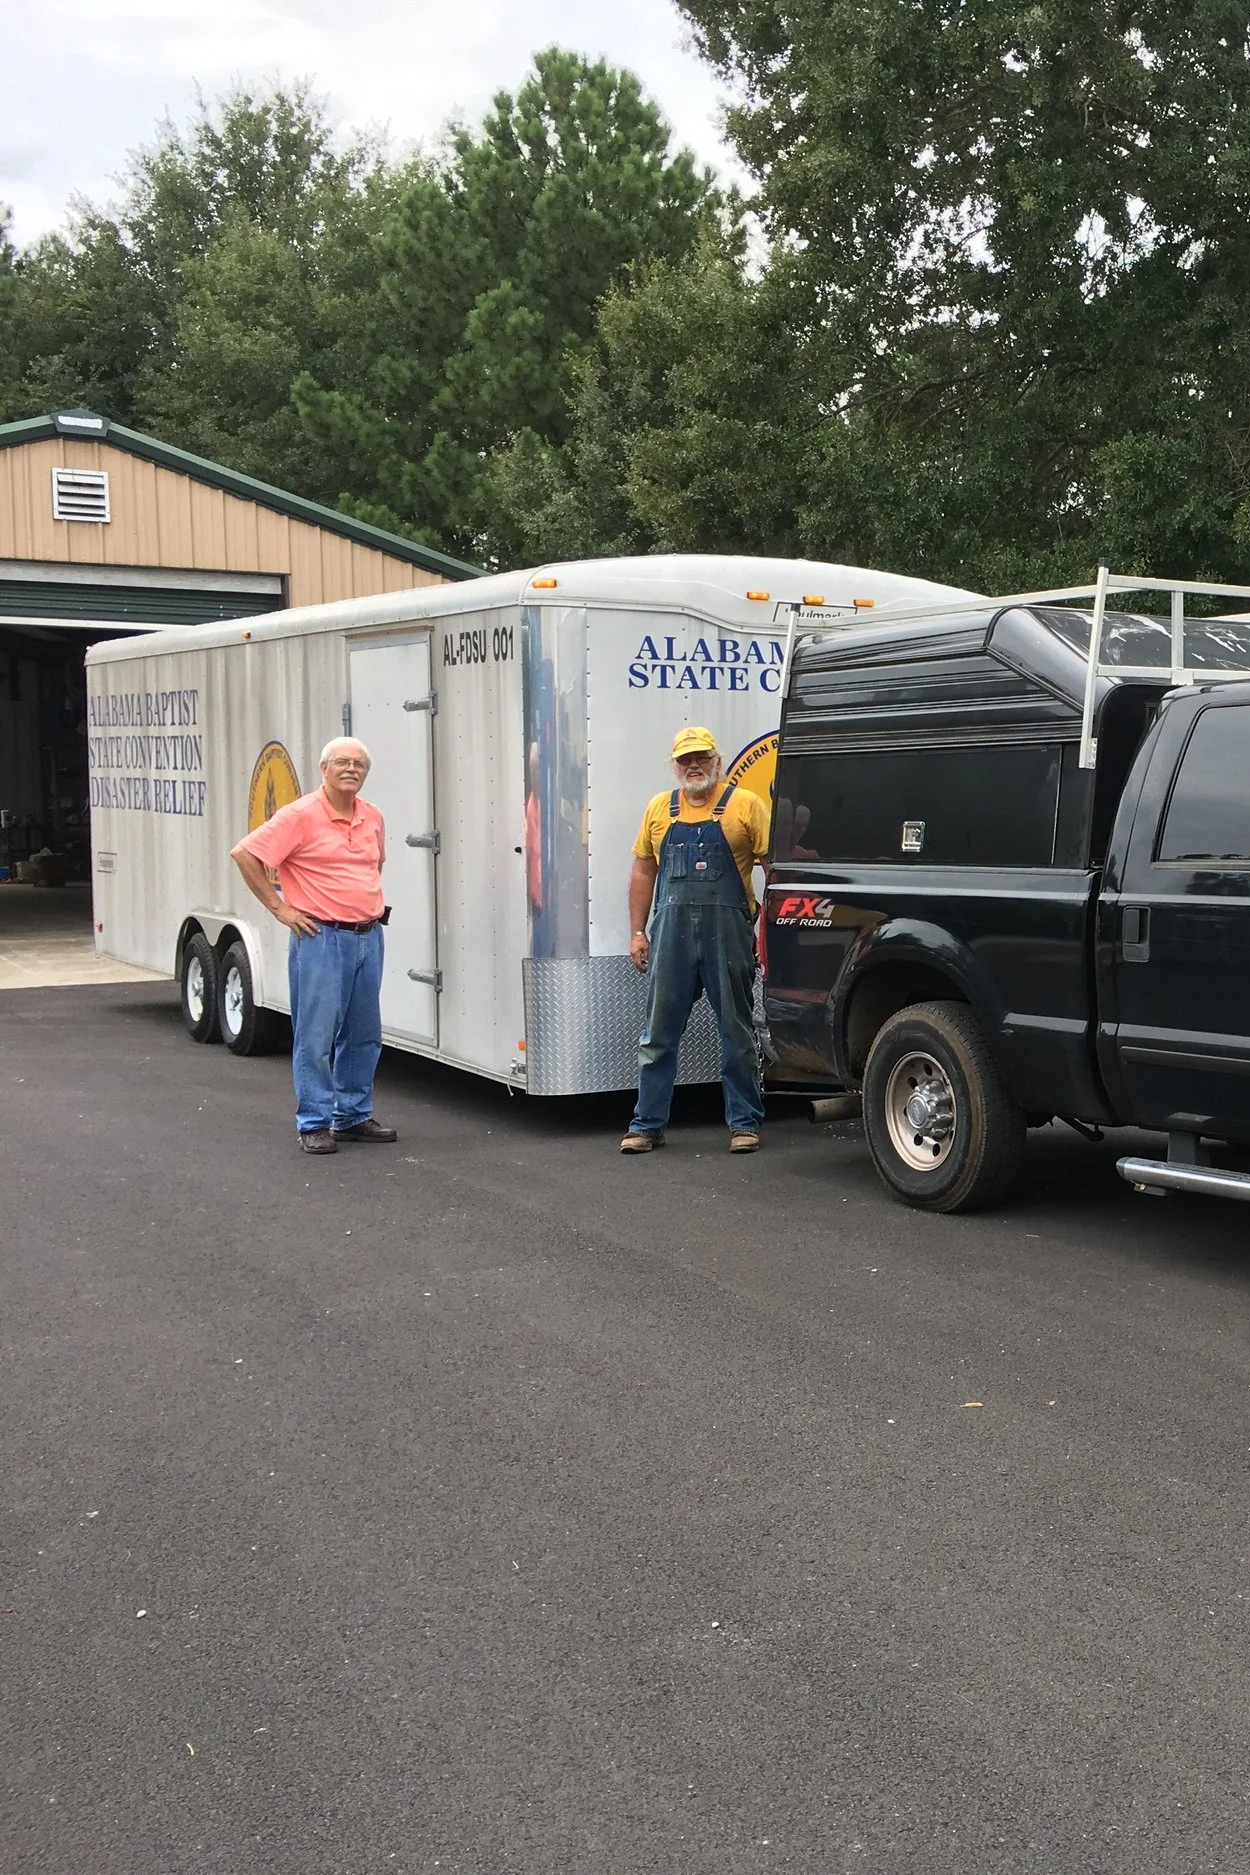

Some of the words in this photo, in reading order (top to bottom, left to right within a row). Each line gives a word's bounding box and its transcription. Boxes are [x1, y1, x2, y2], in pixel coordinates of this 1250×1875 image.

[443, 629, 487, 667] AL-FDSU
[493, 625, 514, 662] 001
[635, 635, 784, 665] ALABAM
[628, 662, 749, 692] STATE
[89, 693, 143, 727] ALABAMA
[145, 689, 199, 727] BAPTIST
[89, 736, 123, 769] STATE
[124, 734, 203, 772] CONVENTION
[728, 743, 770, 787] UTHERN
[91, 776, 151, 812] DISASTER
[152, 779, 207, 817] RELIEF
[776, 917, 797, 925] OFF
[799, 918, 832, 927] ROAD
[778, 897, 835, 918] FX4
